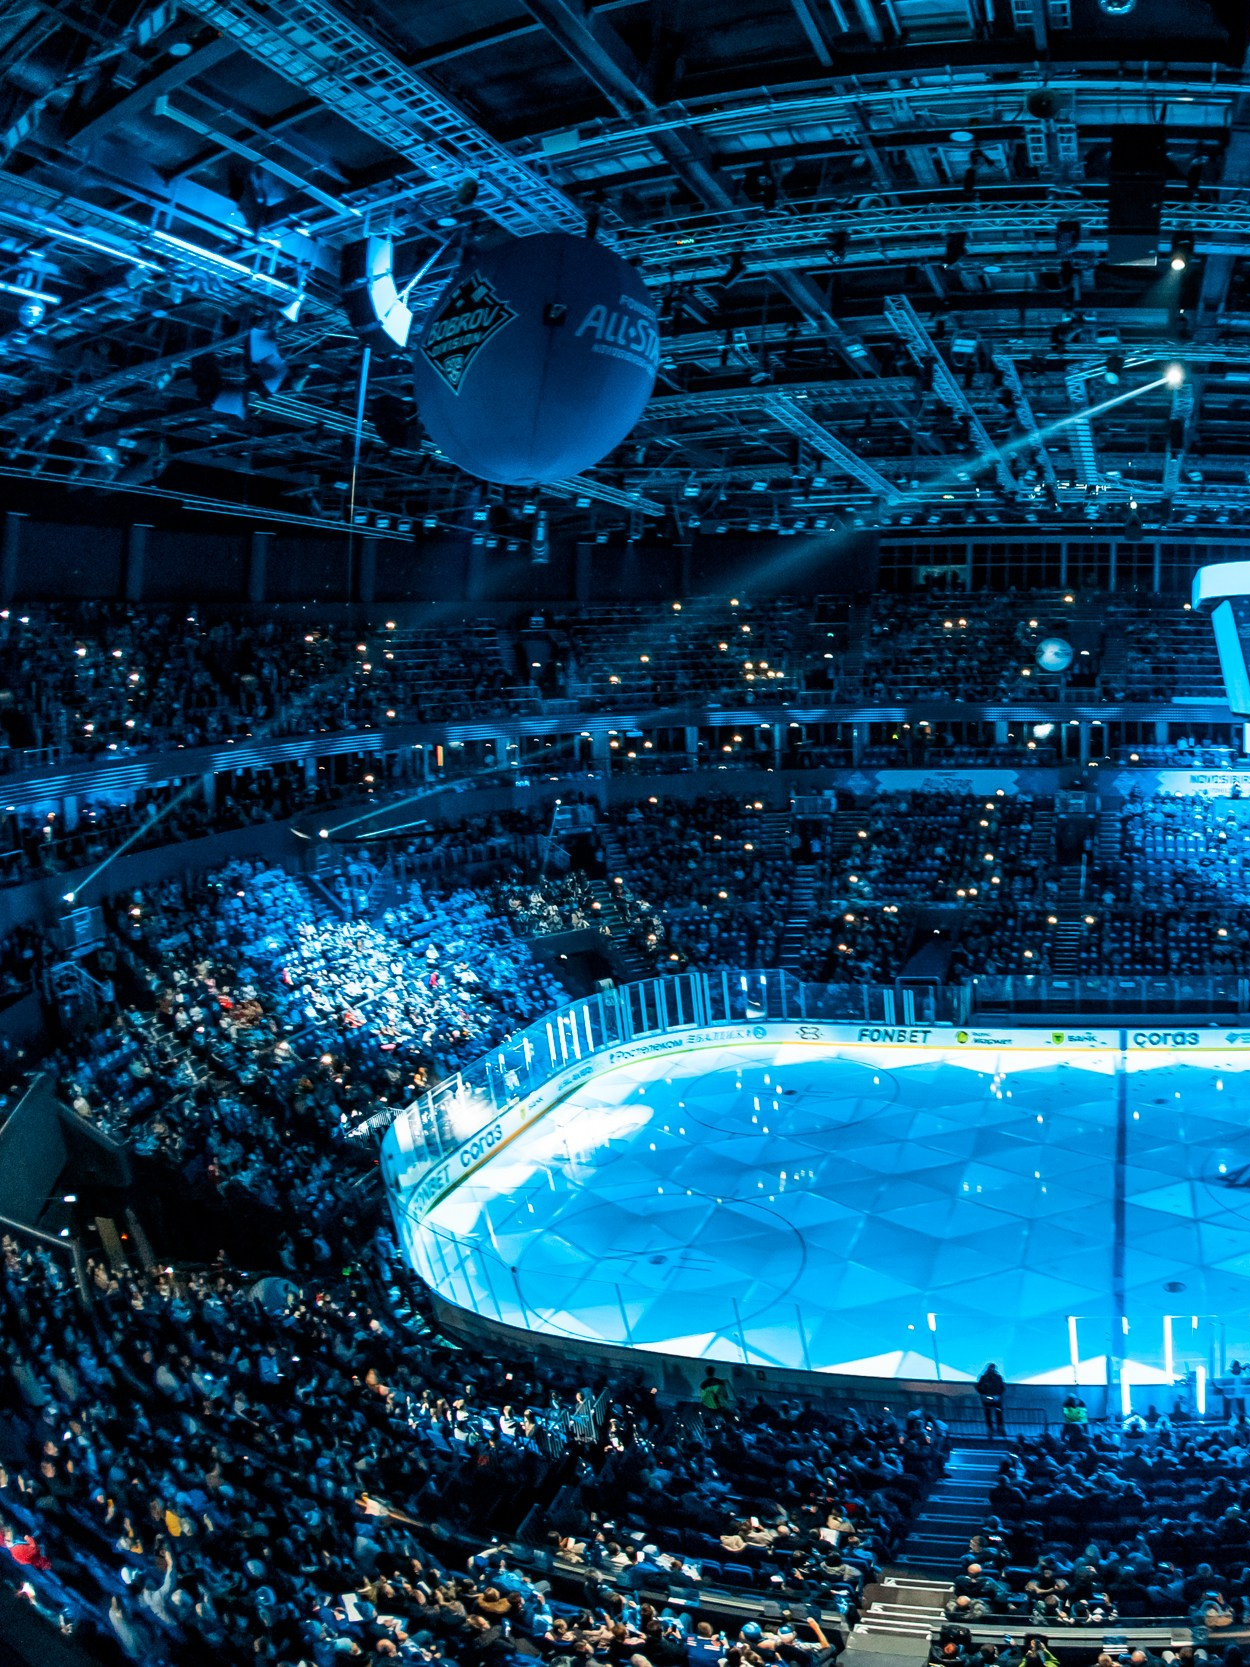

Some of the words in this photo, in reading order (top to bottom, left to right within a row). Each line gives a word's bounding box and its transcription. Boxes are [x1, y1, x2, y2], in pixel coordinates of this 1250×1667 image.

[427, 306, 500, 346] BOBROV
[432, 332, 482, 356] DIVISION
[858, 1028, 933, 1045] FONBET
